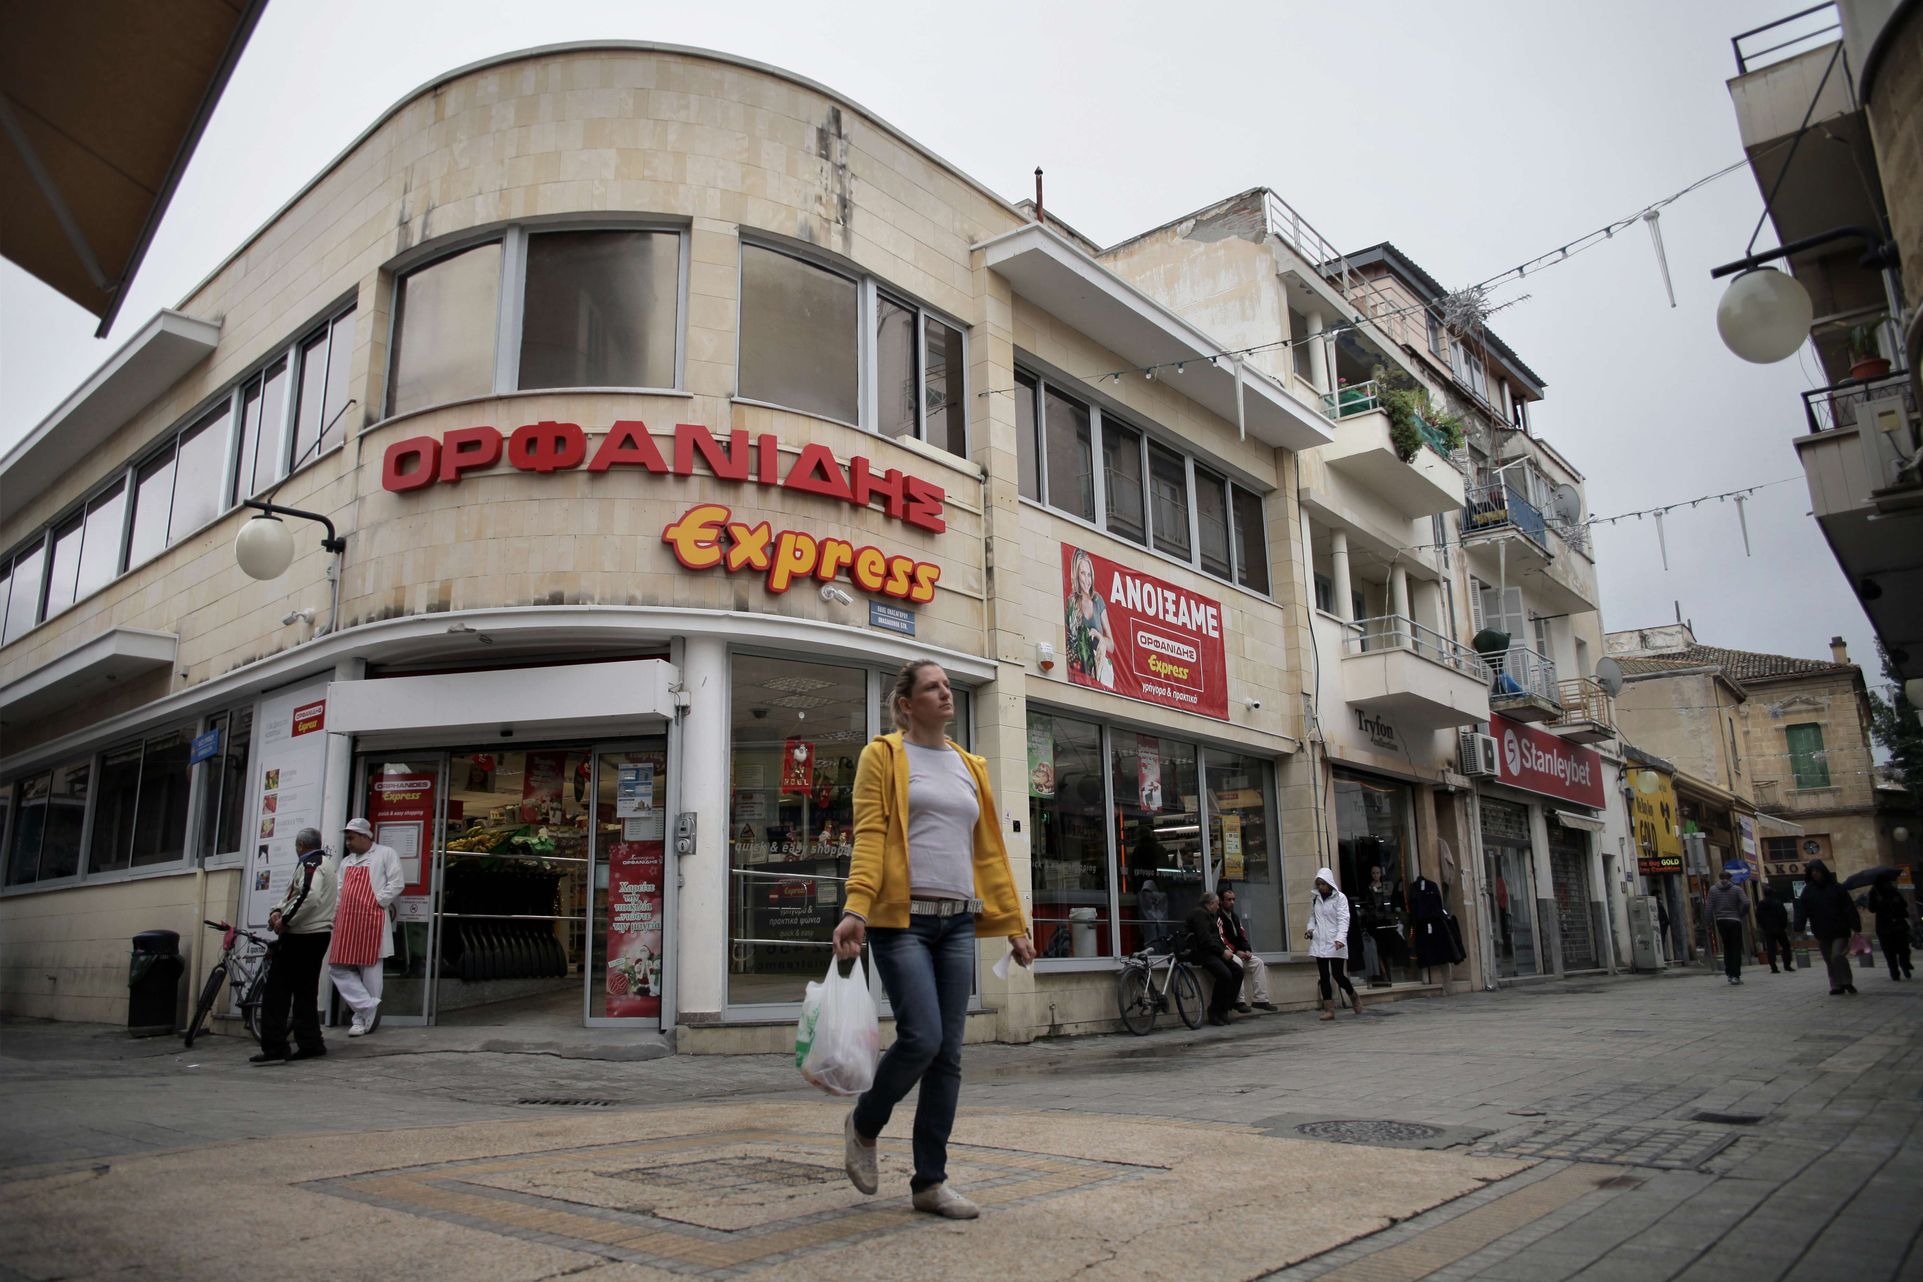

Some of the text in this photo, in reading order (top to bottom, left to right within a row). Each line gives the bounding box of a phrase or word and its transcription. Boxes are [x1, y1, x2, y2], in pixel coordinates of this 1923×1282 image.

[382, 420, 946, 534] ΟΡΦΑΝΙΔΗΣ
[662, 503, 943, 604] Express
[1110, 571, 1220, 639] ΑΝΟΙΞΑΜΕ
[1139, 634, 1196, 660] ΟΡΦΑΝΙΔΗΣ
[1147, 655, 1190, 680] Express
[1355, 708, 1394, 742] Tryfon
[1521, 738, 1591, 786] Stanleybet
[377, 781, 428, 789] ORPHANIDES
[383, 791, 422, 803] Express
[770, 841, 779, 853] &
